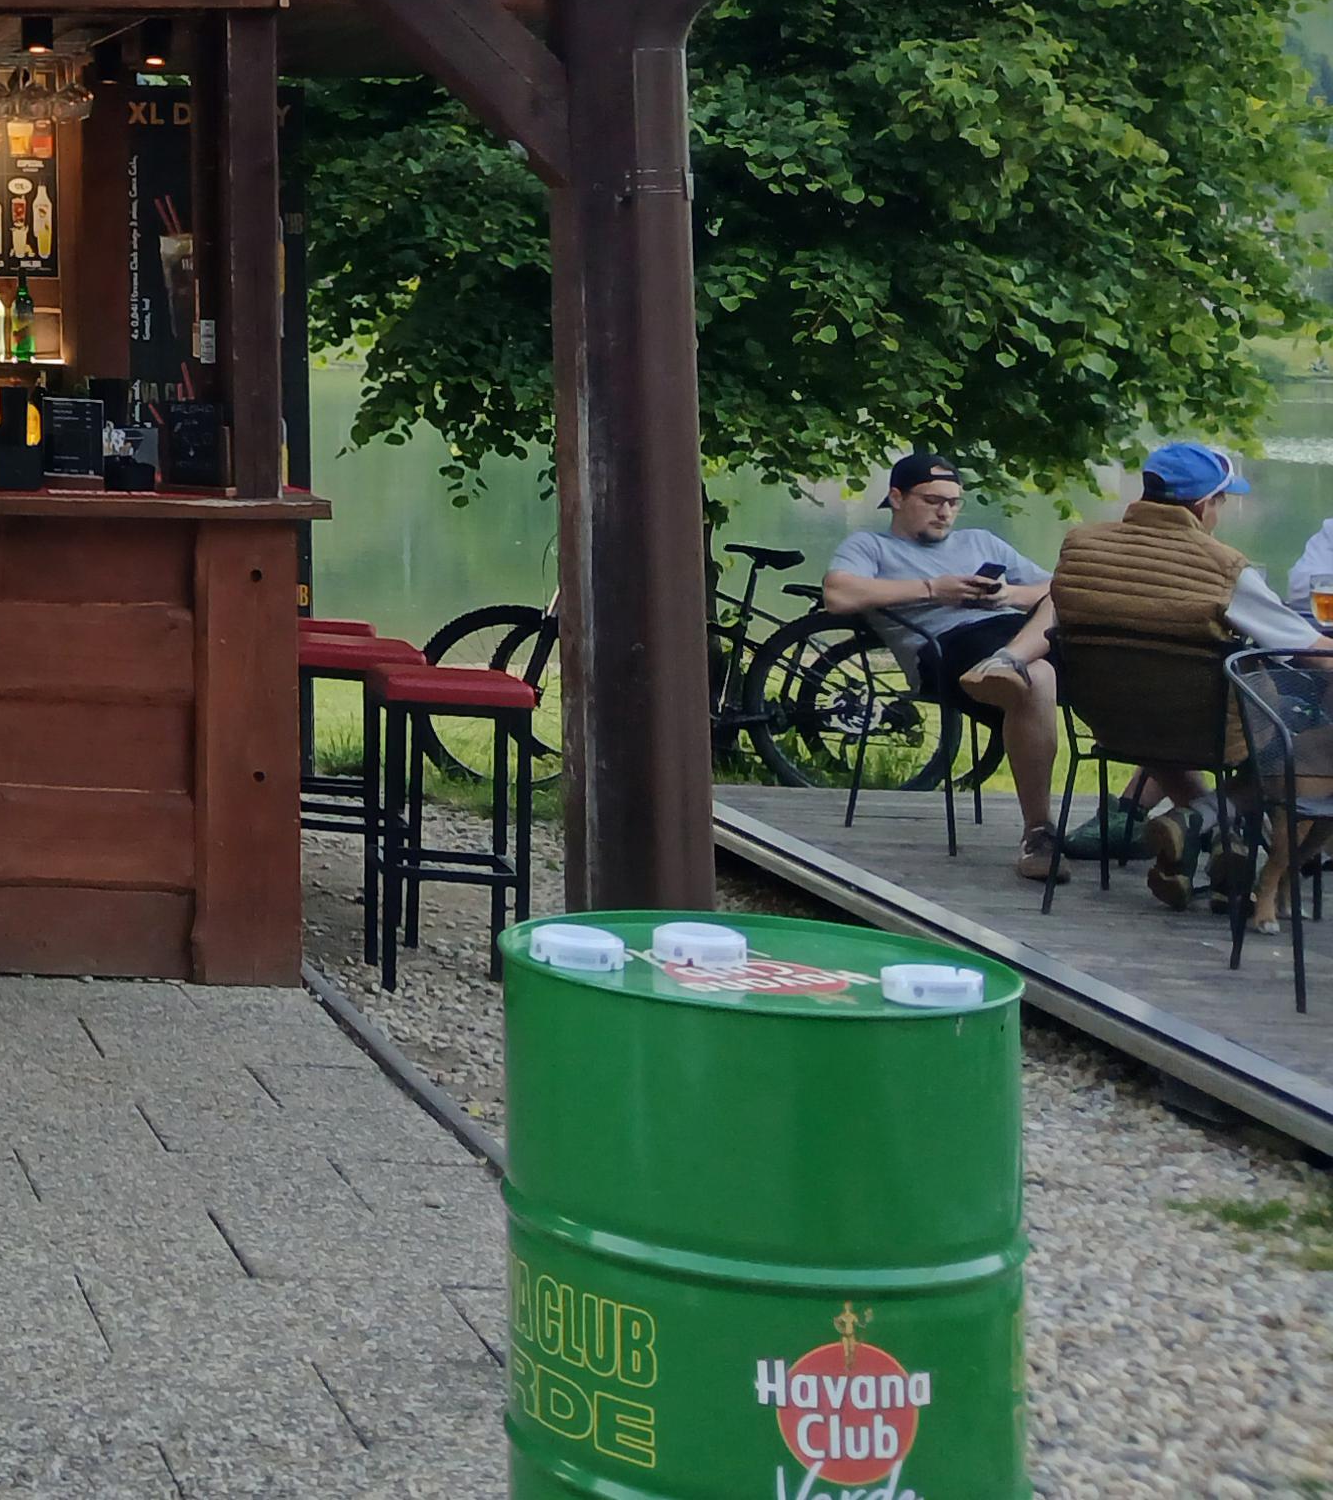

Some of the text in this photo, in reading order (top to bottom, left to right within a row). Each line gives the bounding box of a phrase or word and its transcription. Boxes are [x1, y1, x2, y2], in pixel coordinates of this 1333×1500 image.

[535, 1274, 657, 1389] CLUB
[511, 1340, 656, 1468] RDE
[754, 1359, 931, 1409] Havana
[796, 1413, 899, 1460] Club
